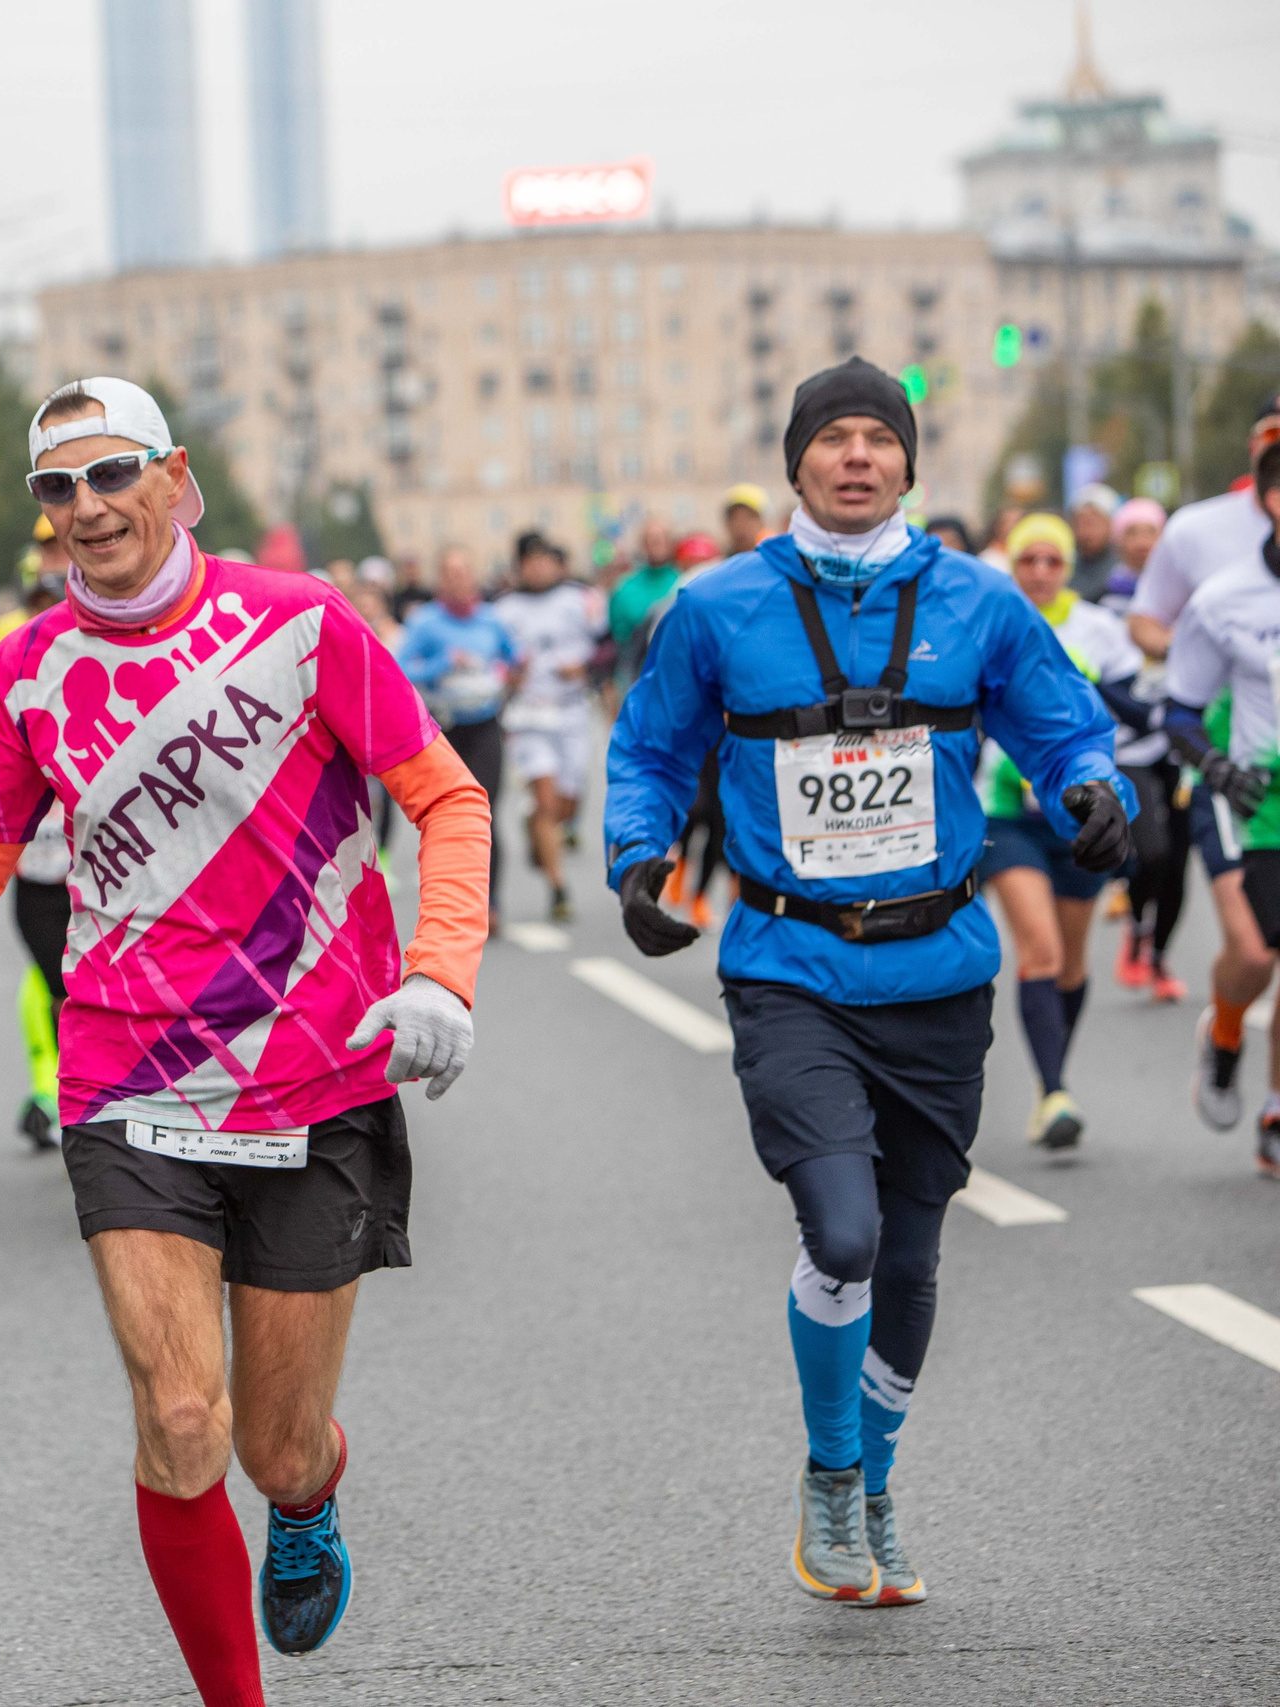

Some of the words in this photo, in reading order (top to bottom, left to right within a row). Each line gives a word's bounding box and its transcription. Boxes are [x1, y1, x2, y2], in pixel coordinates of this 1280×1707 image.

[80, 684, 283, 908] АНГАРКА
[799, 766, 913, 816] 9822
[825, 811, 893, 831] НИКОЛАЙ
[800, 840, 815, 864] F
[151, 1125, 169, 1145] F
[210, 1149, 237, 1157] FONBET
